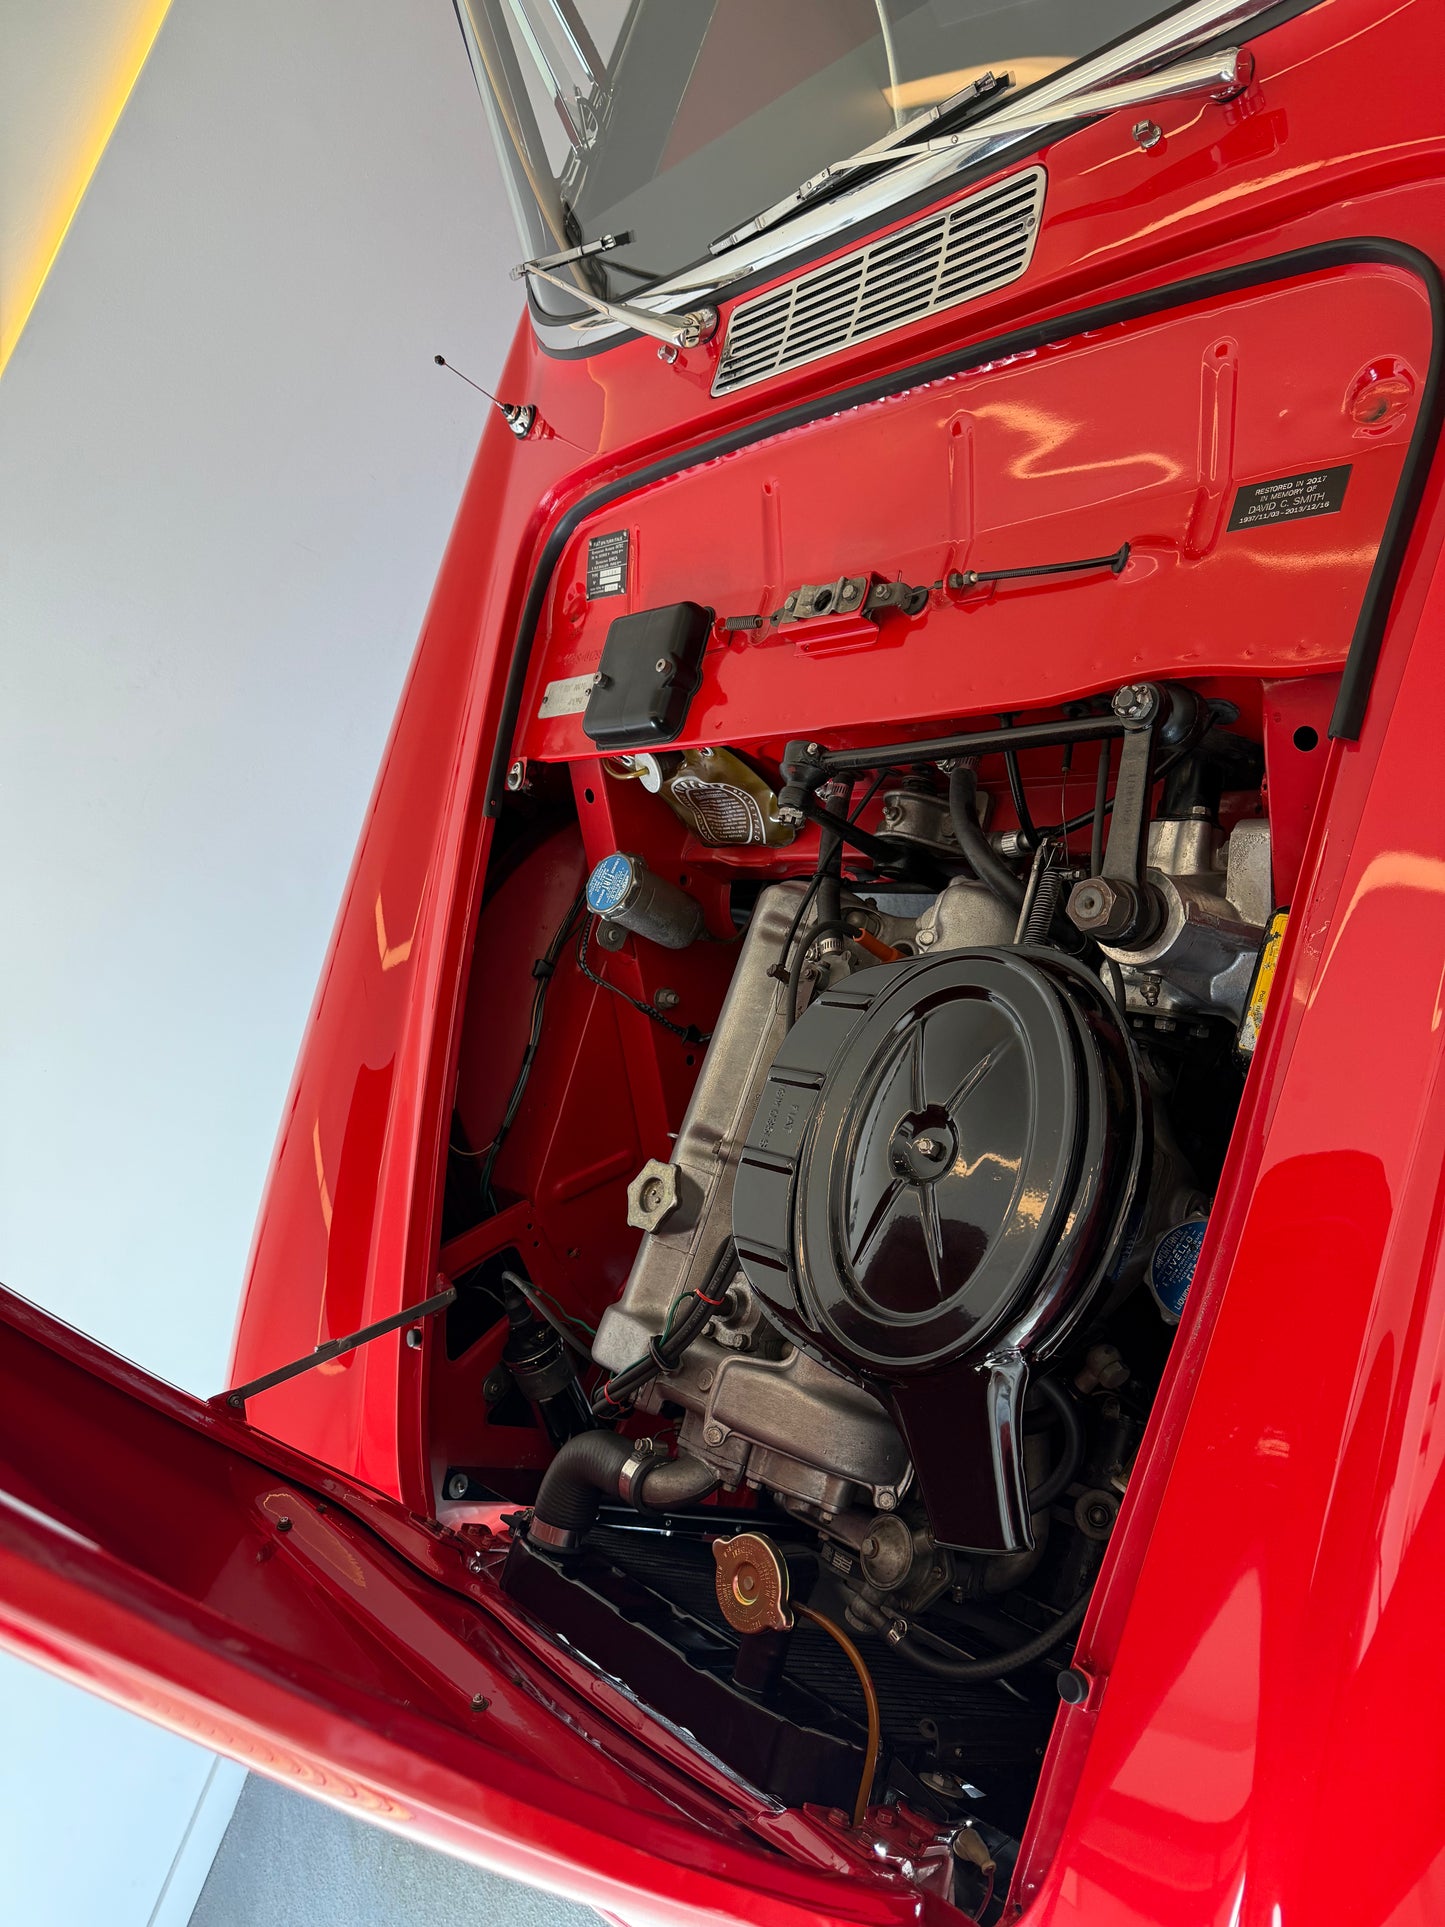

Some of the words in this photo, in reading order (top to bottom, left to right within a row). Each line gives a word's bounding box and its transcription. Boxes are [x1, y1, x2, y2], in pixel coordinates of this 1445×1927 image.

[1255, 482, 1293, 496] RESTORED
[1295, 480, 1304, 488] IN
[1306, 475, 1328, 486] 2017
[1270, 488, 1304, 500] MEMORY
[1306, 485, 1318, 493] OF
[1248, 501, 1277, 515] DAVID
[1280, 500, 1289, 508] C.
[1293, 492, 1326, 506] SMITH
[733, 789, 761, 842] BREVETTATO
[601, 873, 615, 890] FIAT
[1155, 1229, 1184, 1269] IMPORTANTE
[1165, 1235, 1194, 1276] LIVELLO
